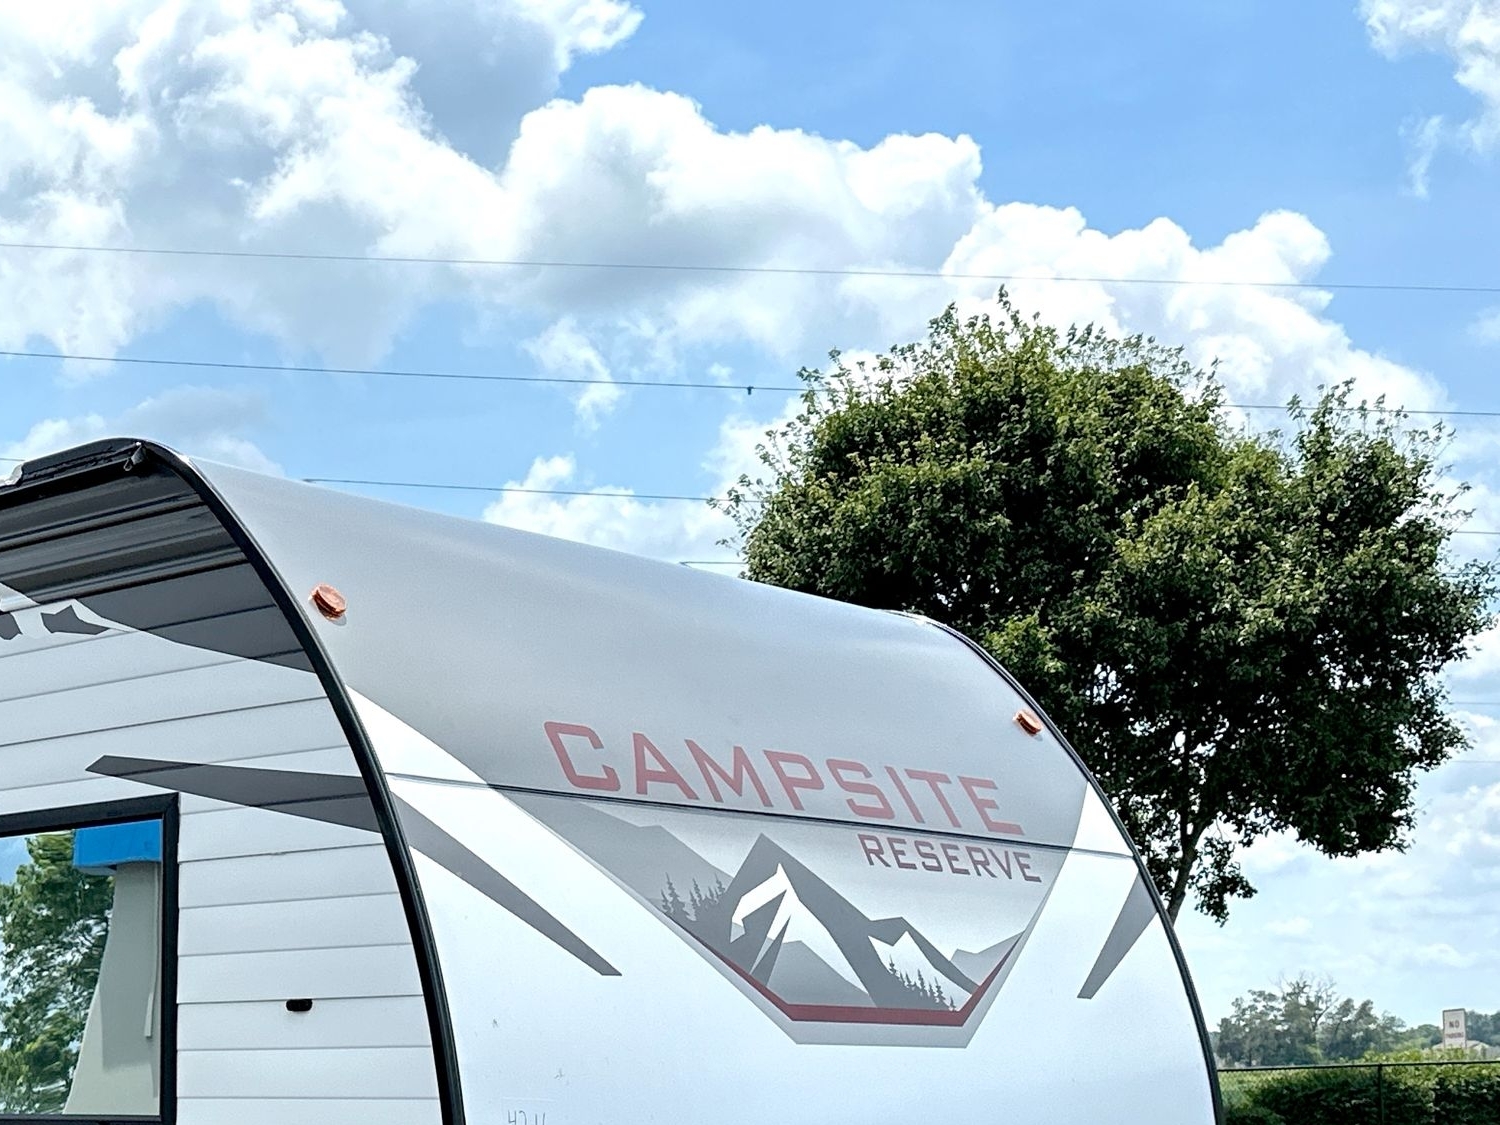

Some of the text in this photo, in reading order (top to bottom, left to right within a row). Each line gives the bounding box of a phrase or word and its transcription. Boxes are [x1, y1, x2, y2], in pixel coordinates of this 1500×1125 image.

[543, 720, 1025, 836] CAMPSITE
[857, 833, 1042, 884] RESERVE
[1449, 1020, 1459, 1028] NO
